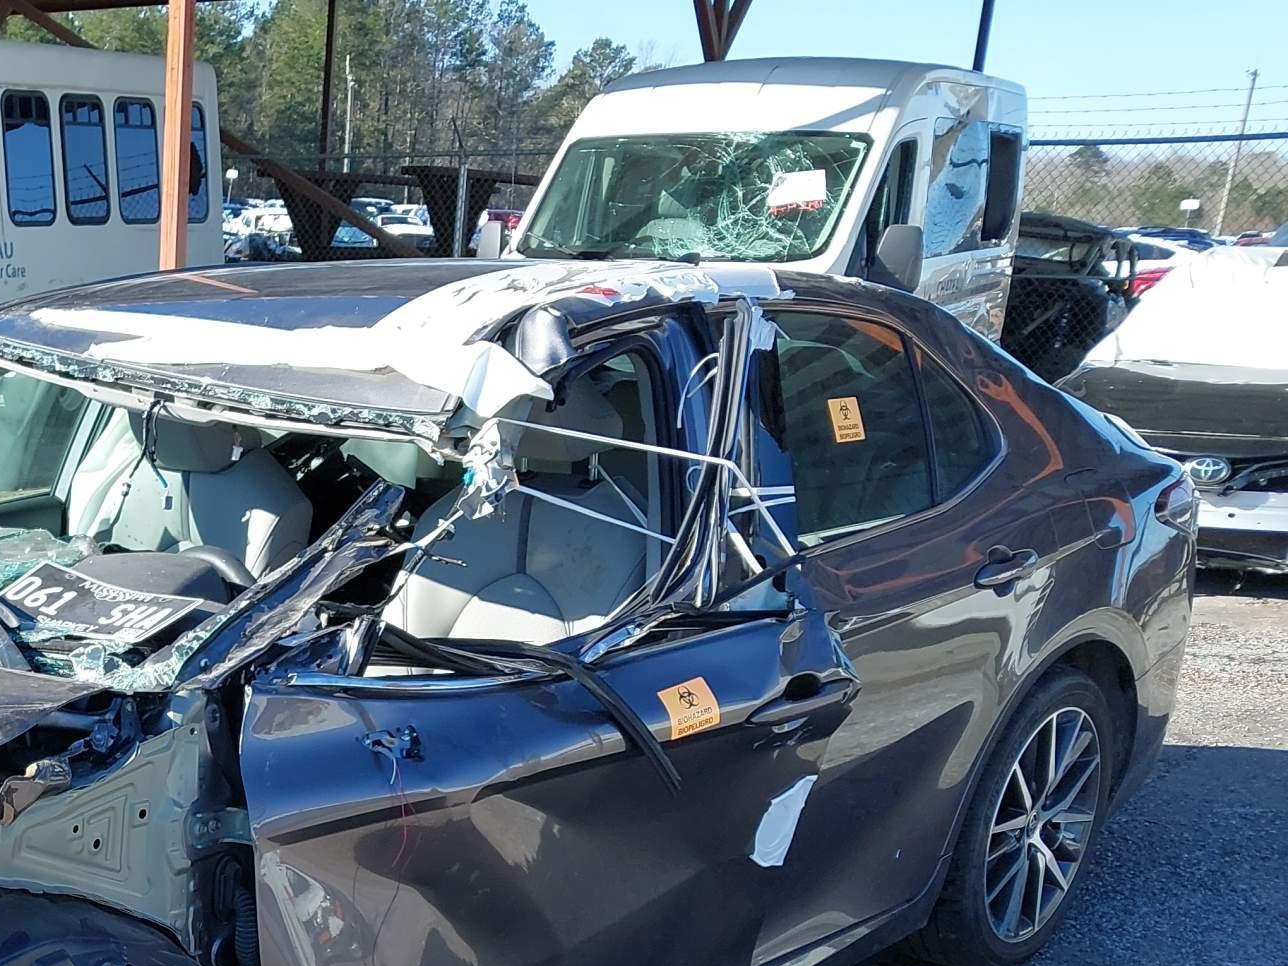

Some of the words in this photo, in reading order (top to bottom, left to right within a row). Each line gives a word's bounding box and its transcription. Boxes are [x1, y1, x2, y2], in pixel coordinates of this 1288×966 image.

[5, 263, 26, 279] Care
[5, 576, 78, 616] 061
[98, 604, 172, 630] SHA
[677, 706, 713, 726] BIOHAZARD
[677, 716, 714, 736] BIOPELIGRO
